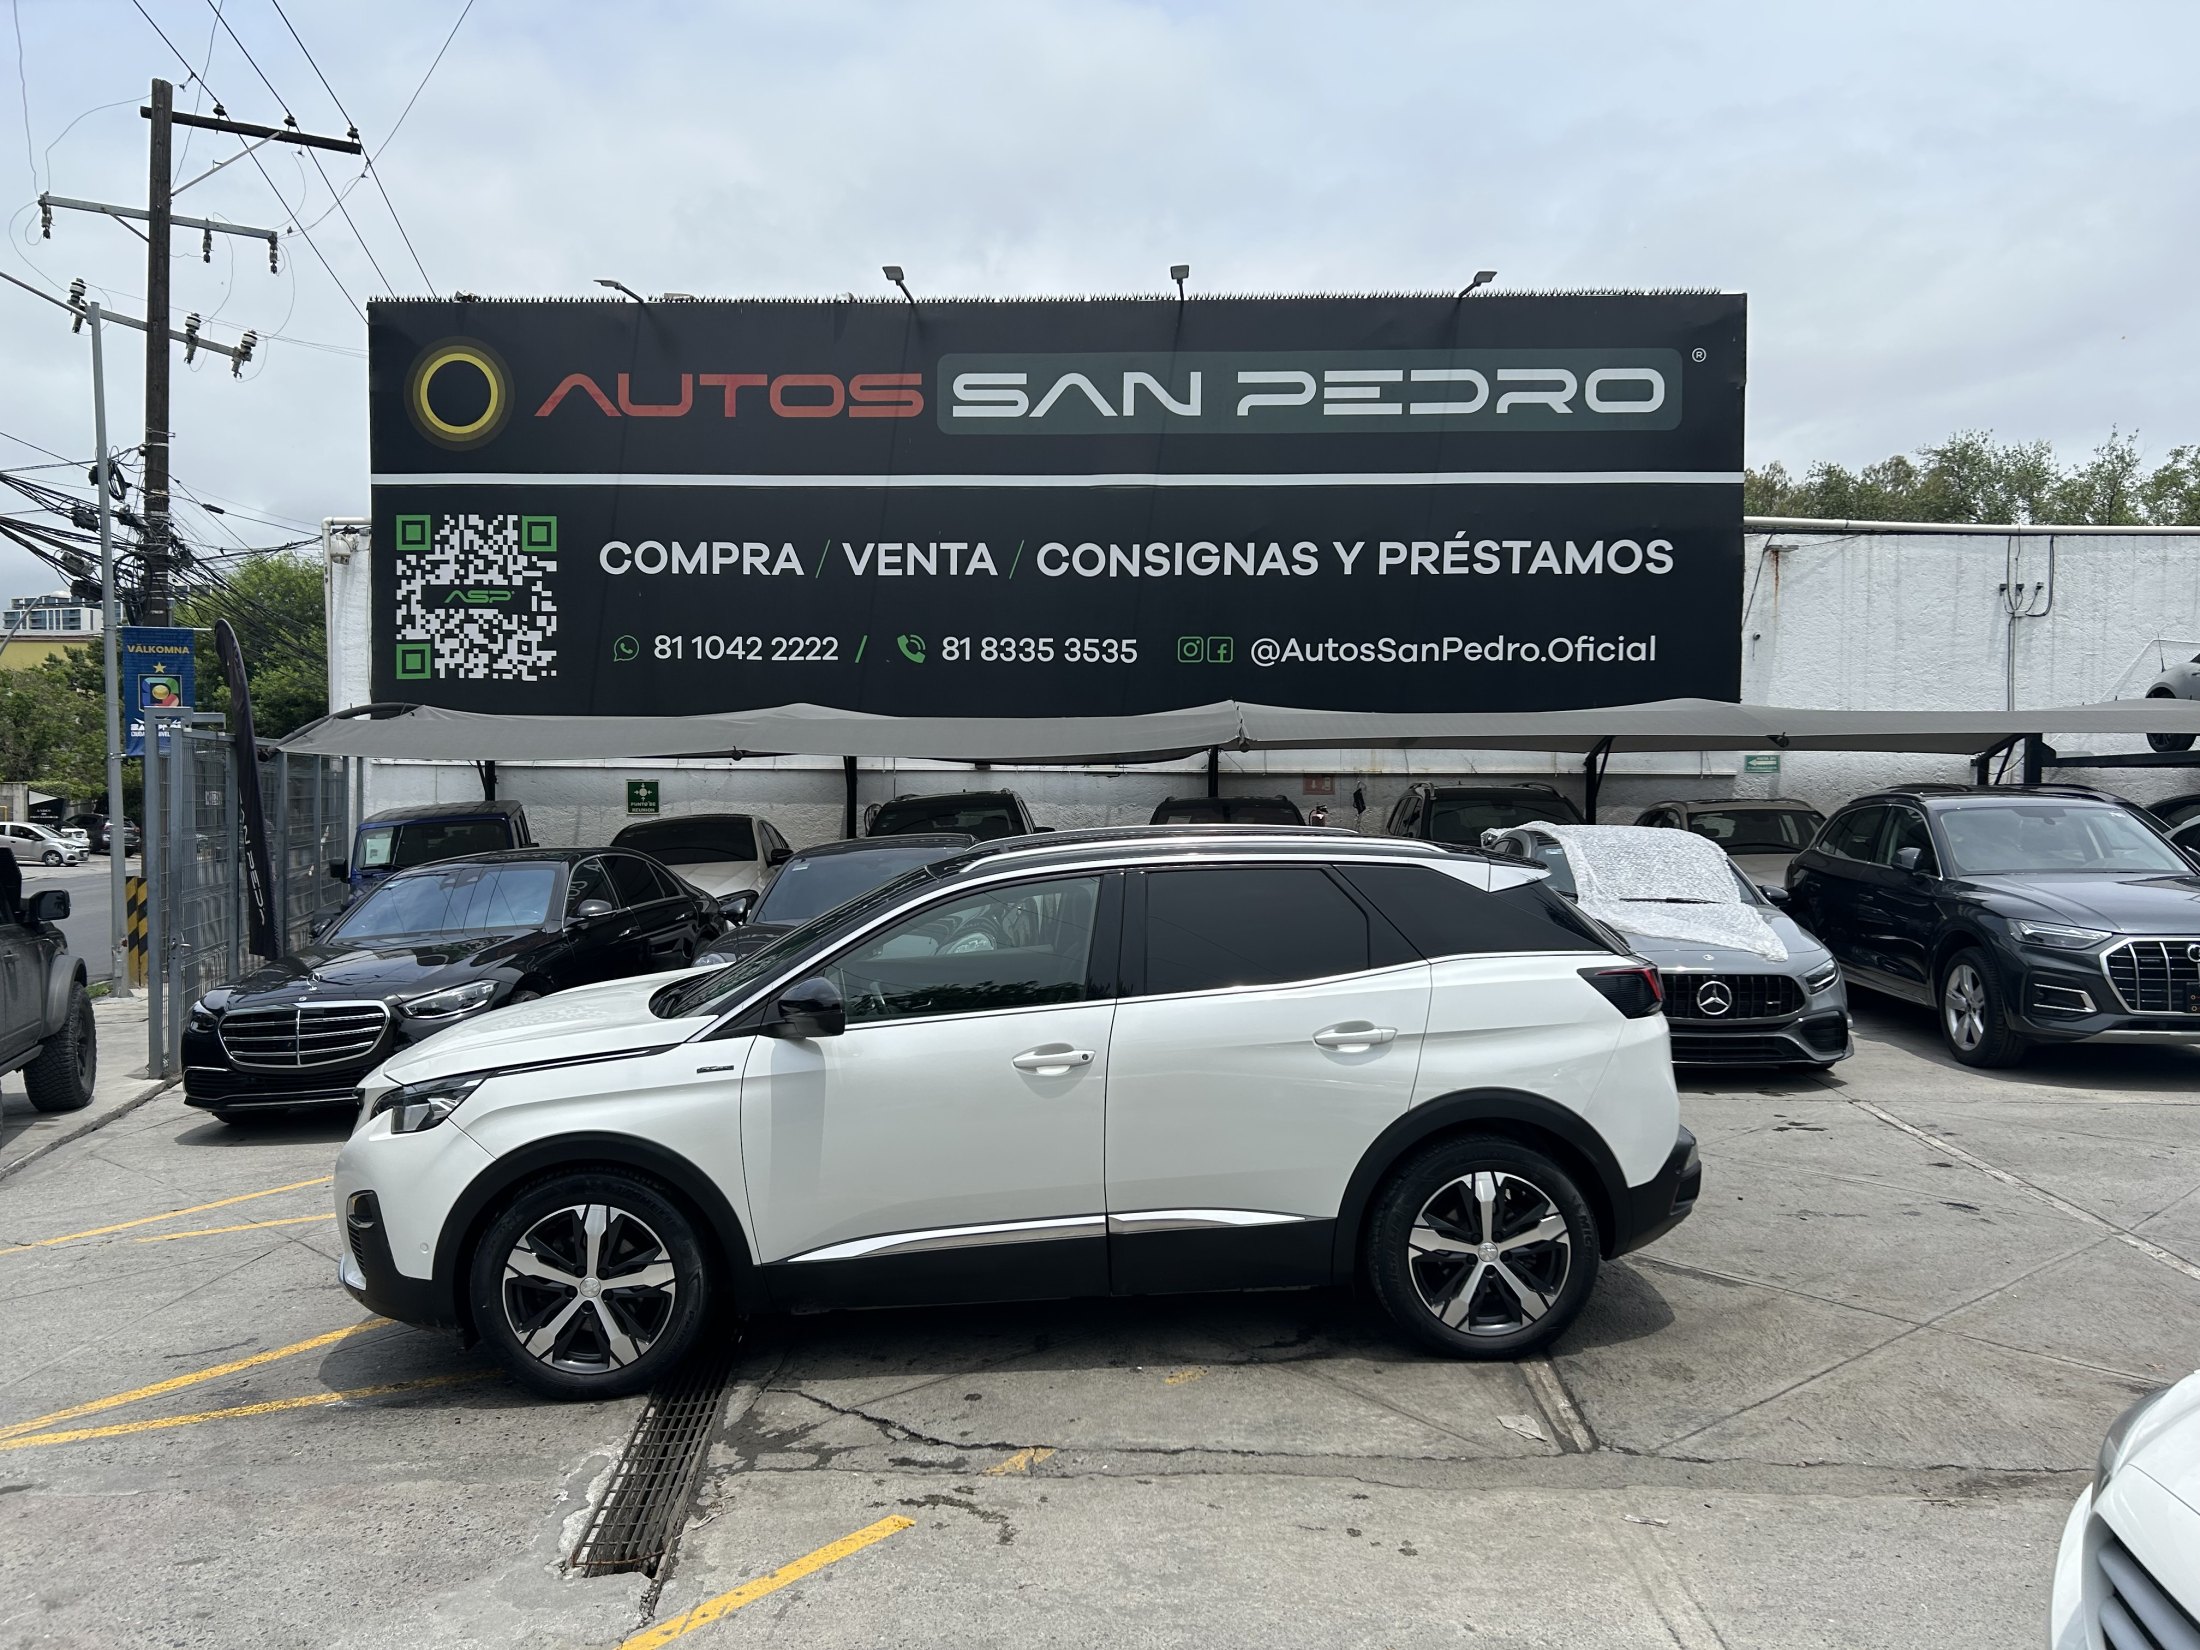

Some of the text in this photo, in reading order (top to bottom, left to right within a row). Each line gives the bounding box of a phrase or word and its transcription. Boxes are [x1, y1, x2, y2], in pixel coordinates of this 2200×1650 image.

[536, 373, 924, 418] AUTOS
[952, 371, 1202, 418] SAN
[1236, 367, 1666, 417] PEDRO
[599, 540, 805, 576] COMPRA
[841, 542, 999, 576] VENTA
[1036, 541, 1319, 577] CONSIGNAS
[1332, 541, 1366, 575] Y
[1378, 530, 1674, 575] PRÉSTAMOS
[444, 589, 512, 604] ASP
[653, 634, 683, 661] 81
[691, 635, 763, 661] 1042
[771, 636, 839, 662] 2222
[941, 636, 1138, 665] 81 8335 3535
[1250, 635, 1657, 668] @AutosSanPedro.Oficial
